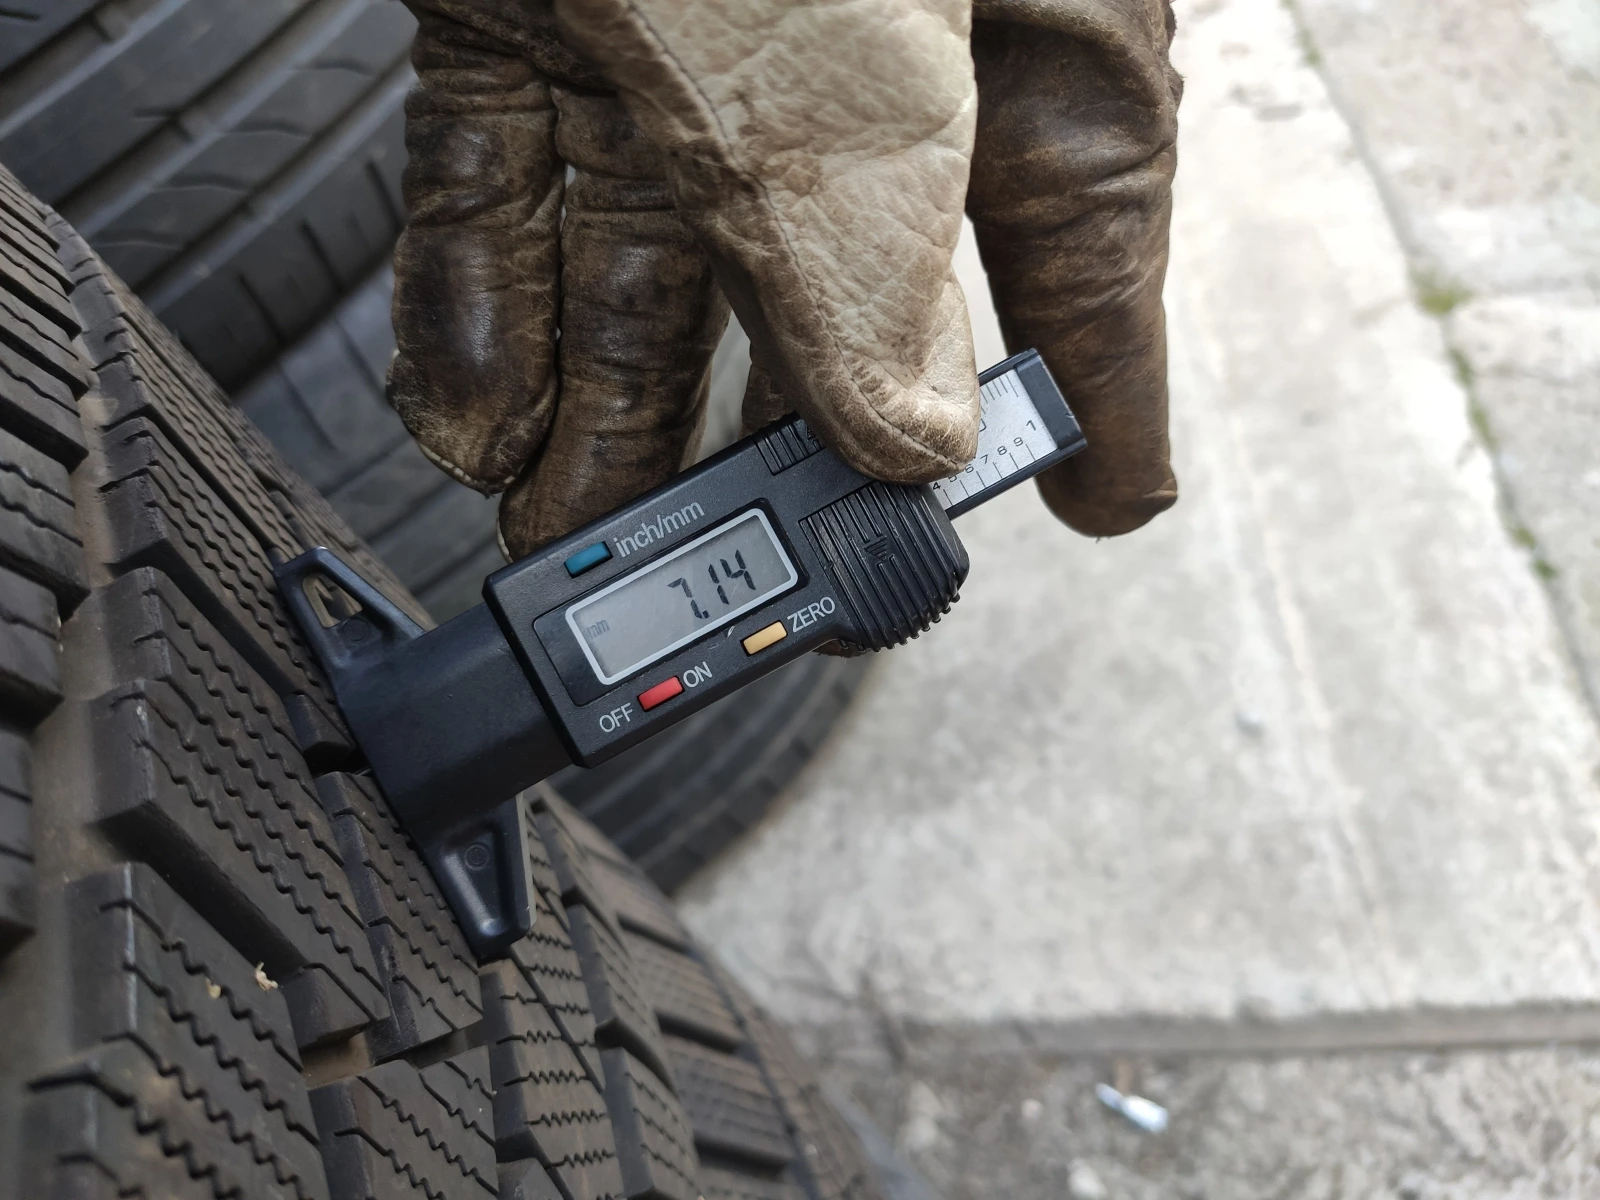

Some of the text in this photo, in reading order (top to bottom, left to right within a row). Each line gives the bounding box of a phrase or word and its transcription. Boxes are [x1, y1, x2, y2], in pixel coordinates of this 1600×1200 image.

[1026, 420, 1036, 431] 1
[932, 482, 941, 490] 4
[964, 464, 974, 473] 6
[980, 454, 989, 464] 7
[997, 445, 1007, 456] 8
[1013, 436, 1023, 447] 9
[613, 501, 705, 558] inch/mm
[667, 549, 756, 619] 7.14
[586, 617, 610, 640] mm
[787, 596, 836, 633] ZERO
[683, 662, 713, 689] ON
[599, 702, 634, 734] OFF
